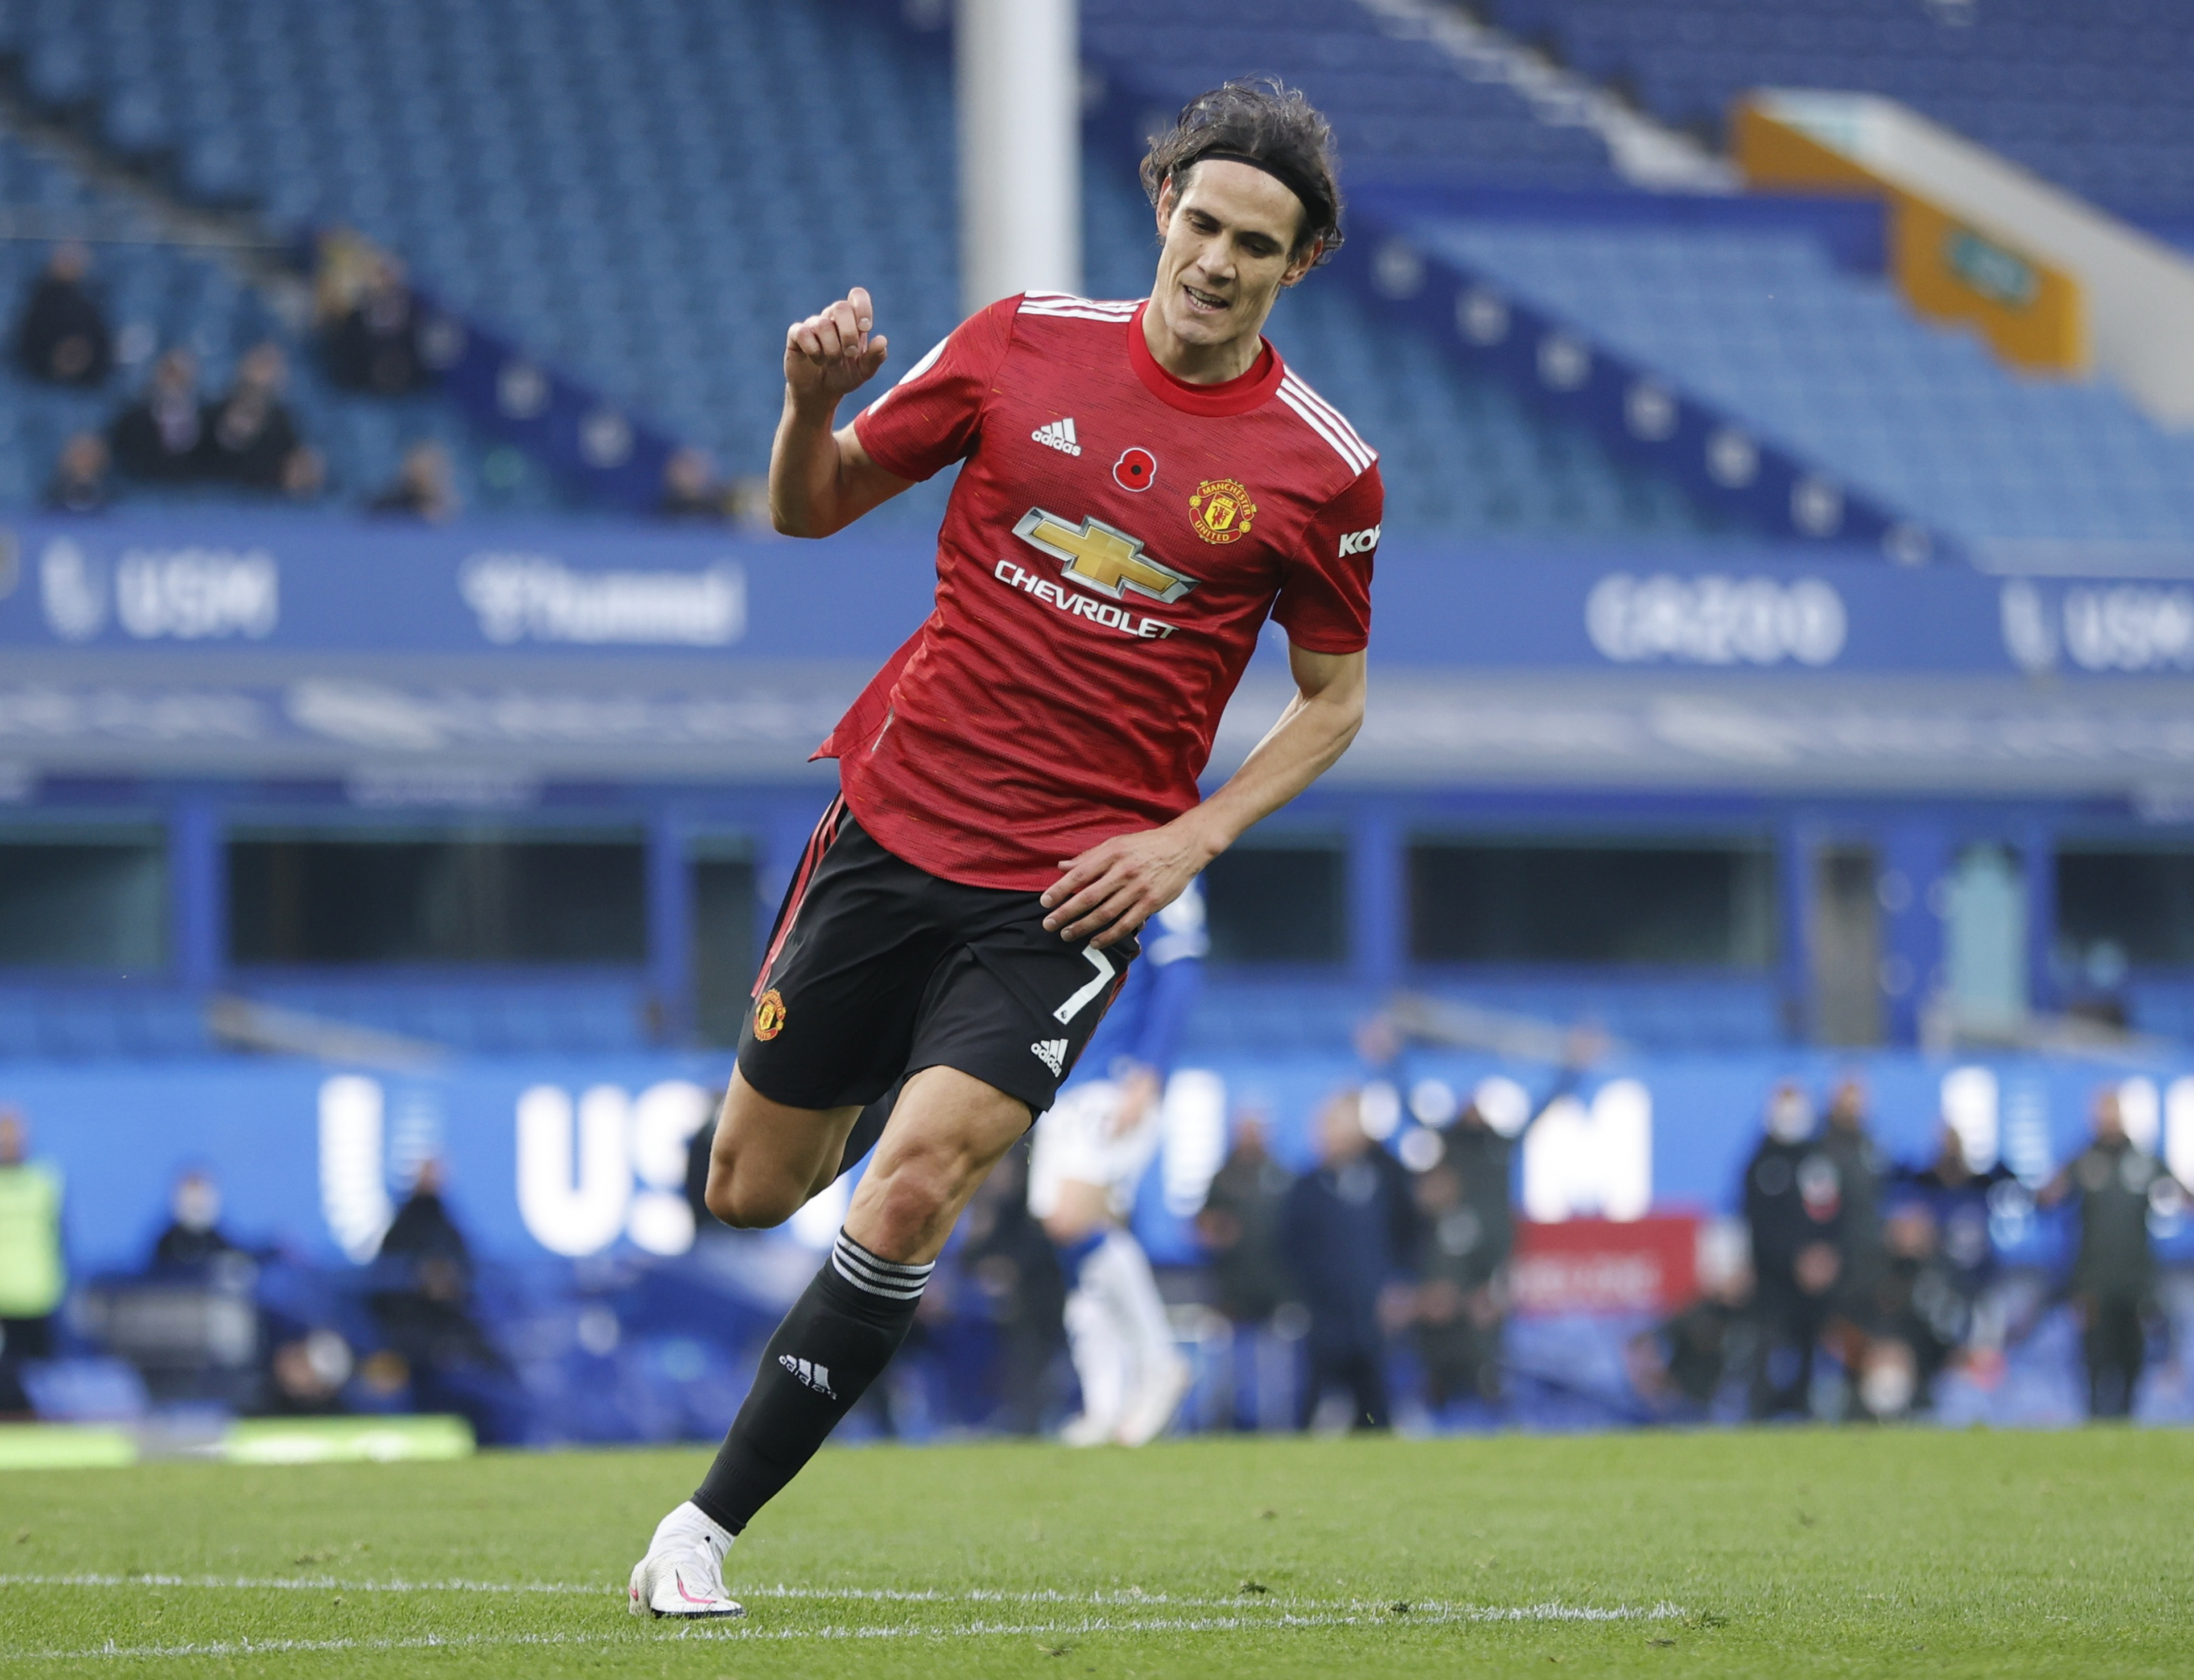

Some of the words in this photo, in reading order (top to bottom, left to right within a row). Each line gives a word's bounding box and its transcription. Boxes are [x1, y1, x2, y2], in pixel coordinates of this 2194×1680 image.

[1031, 430, 1082, 457] adidas
[1201, 482, 1252, 517] MANCHESTER
[1194, 519, 1231, 543] UNITED
[994, 559, 1180, 640] CHEVROLET
[1052, 942, 1116, 1026] 7
[1030, 1042, 1063, 1079] adidas
[778, 1354, 838, 1400] adidas
